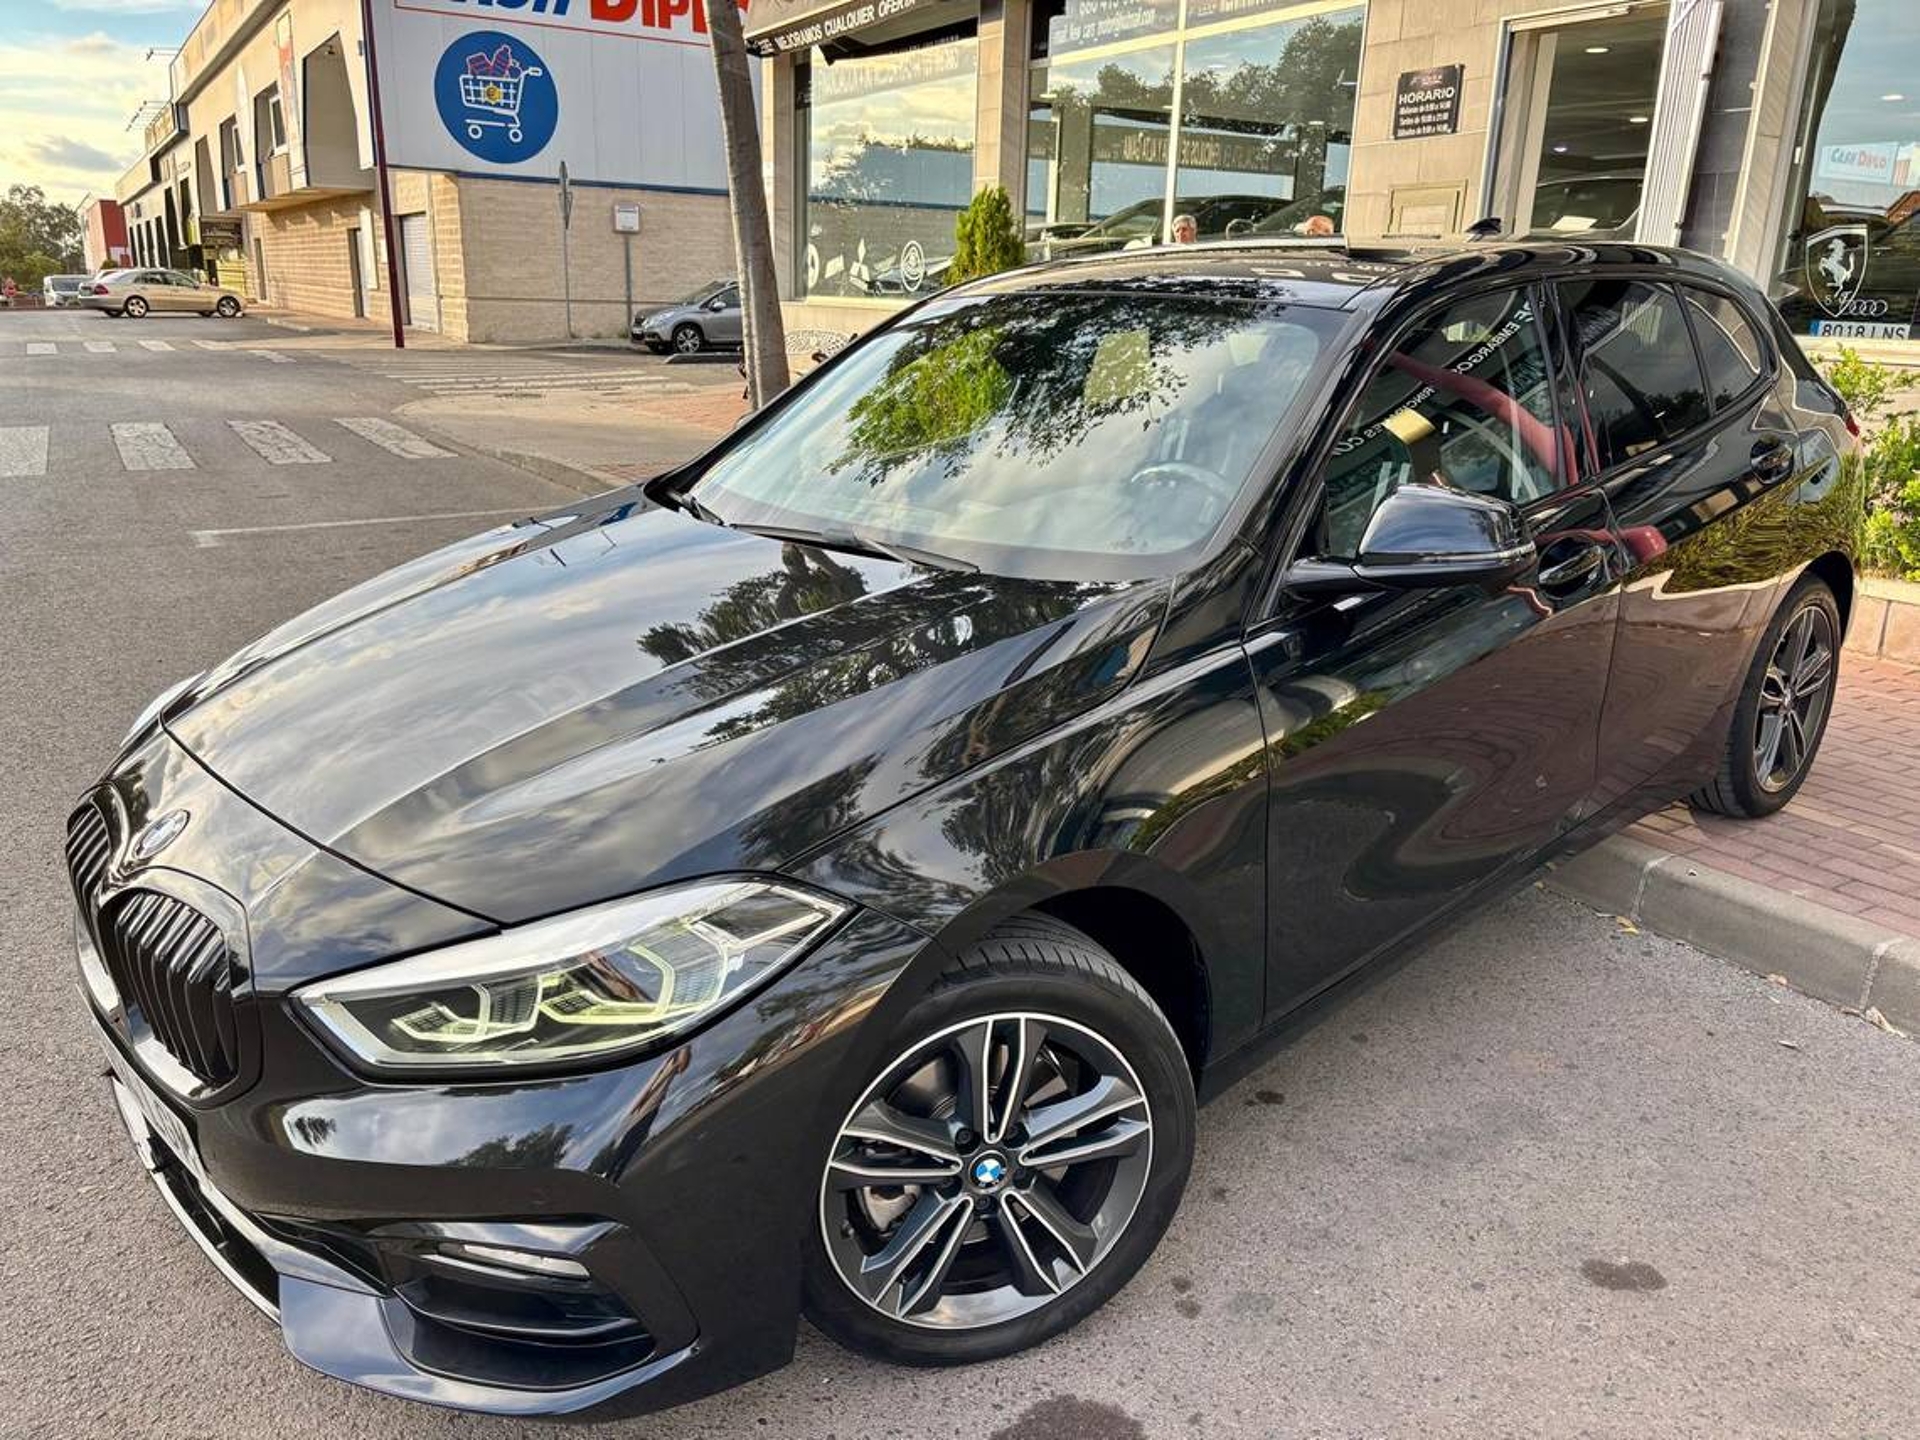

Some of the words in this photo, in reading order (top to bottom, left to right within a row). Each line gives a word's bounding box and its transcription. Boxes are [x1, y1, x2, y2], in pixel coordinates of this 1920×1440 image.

[590, 0, 751, 33] DIP
[774, 25, 823, 50] MEJORAMOS
[824, 5, 875, 36] CUALQUIER
[1398, 86, 1455, 105] HORARIO
[1822, 323, 1865, 338] 8018
